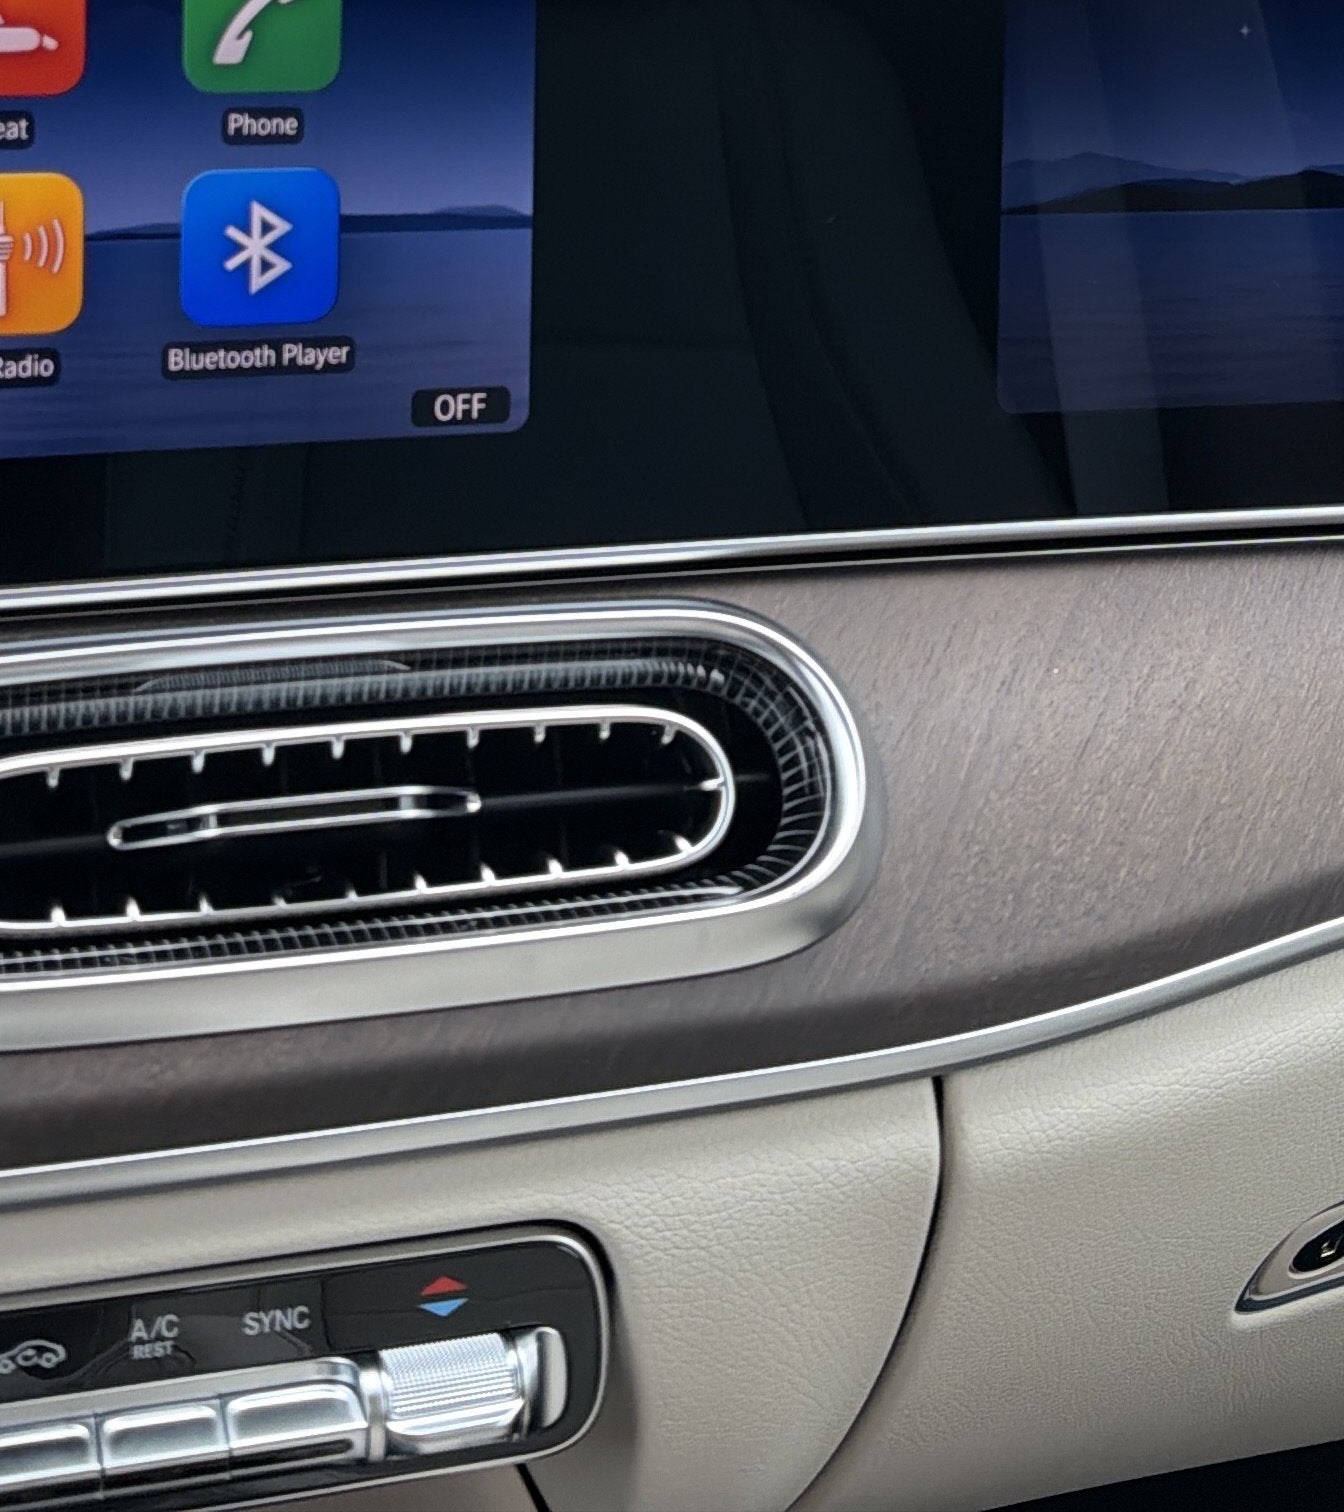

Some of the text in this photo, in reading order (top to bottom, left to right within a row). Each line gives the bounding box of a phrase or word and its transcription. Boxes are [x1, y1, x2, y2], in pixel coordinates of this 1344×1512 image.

[227, 111, 299, 137] Phone
[167, 342, 351, 373] Bluetooth Player
[434, 392, 488, 423] OFF
[129, 1314, 180, 1342] A/C
[241, 1305, 311, 1336] SYNC
[132, 1341, 175, 1360] REST
